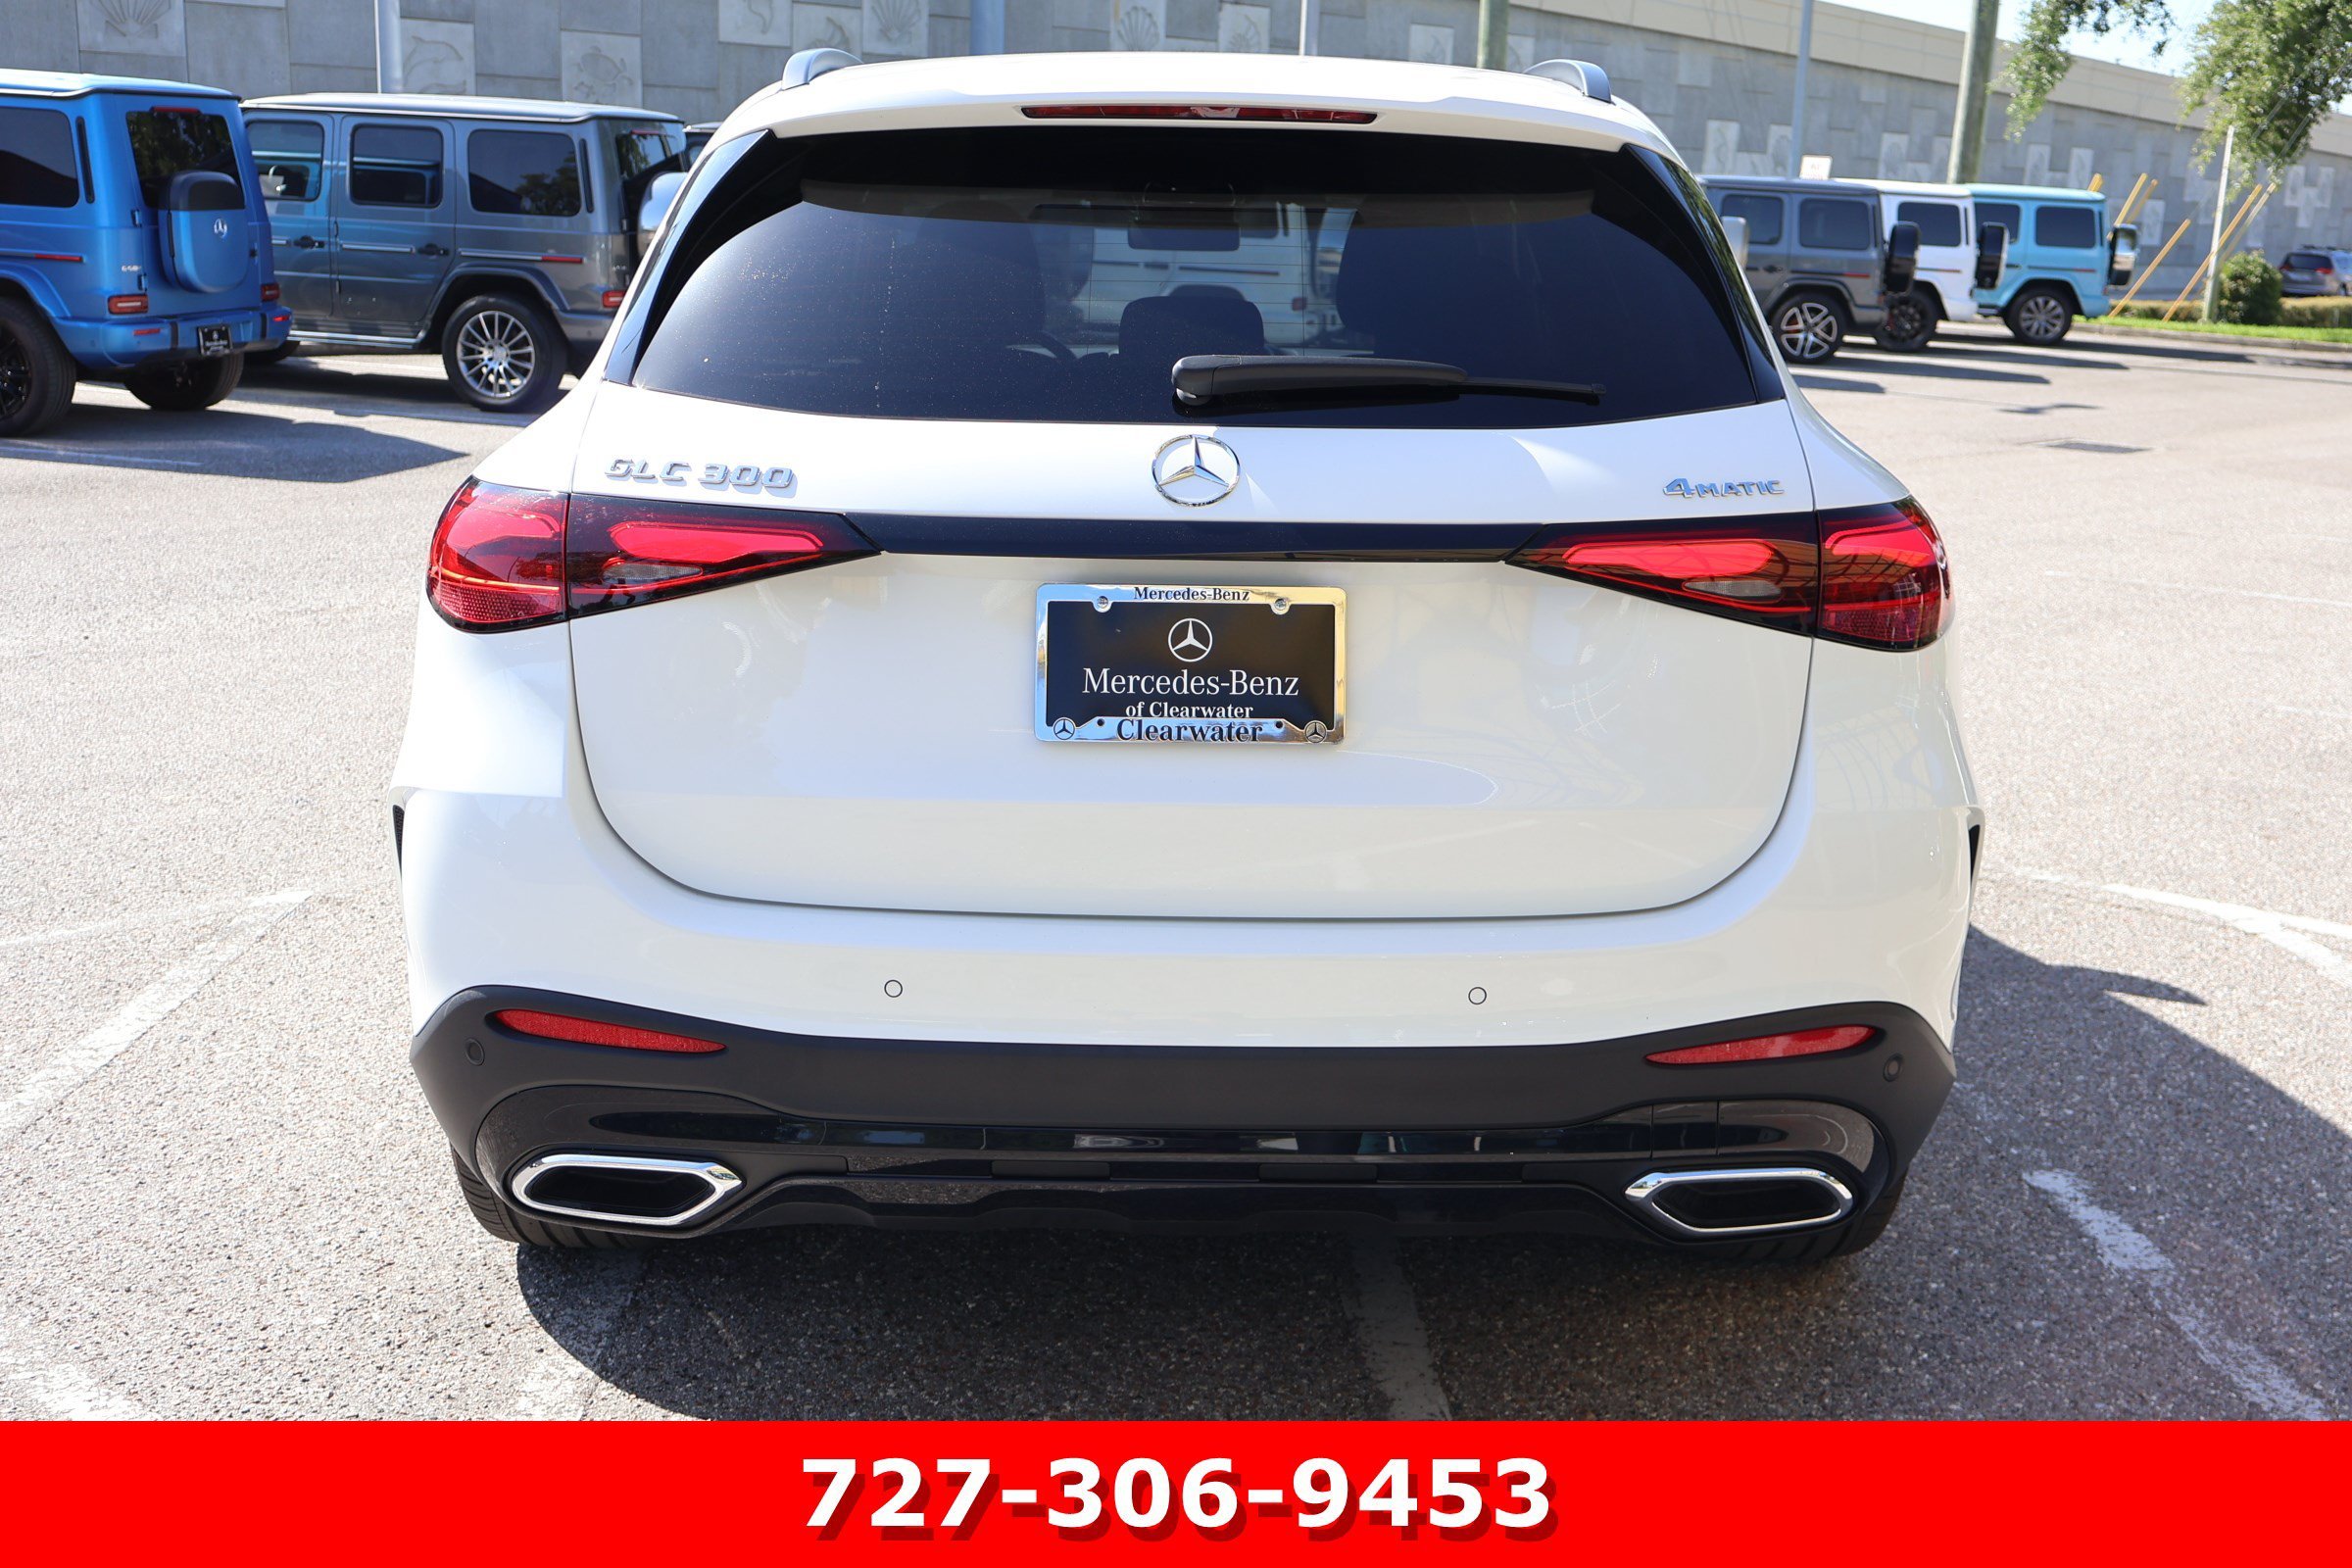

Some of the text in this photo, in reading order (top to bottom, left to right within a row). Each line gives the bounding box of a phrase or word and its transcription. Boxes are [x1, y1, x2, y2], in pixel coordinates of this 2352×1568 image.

[604, 459, 795, 489] GLC 300
[1663, 477, 1785, 498] 4MATIC
[1133, 586, 1250, 602] Mercedes-Benz
[1082, 667, 1299, 696] Mercedes-Benz
[1125, 701, 1254, 719] of Clearwater
[1116, 718, 1263, 743] Clearwater
